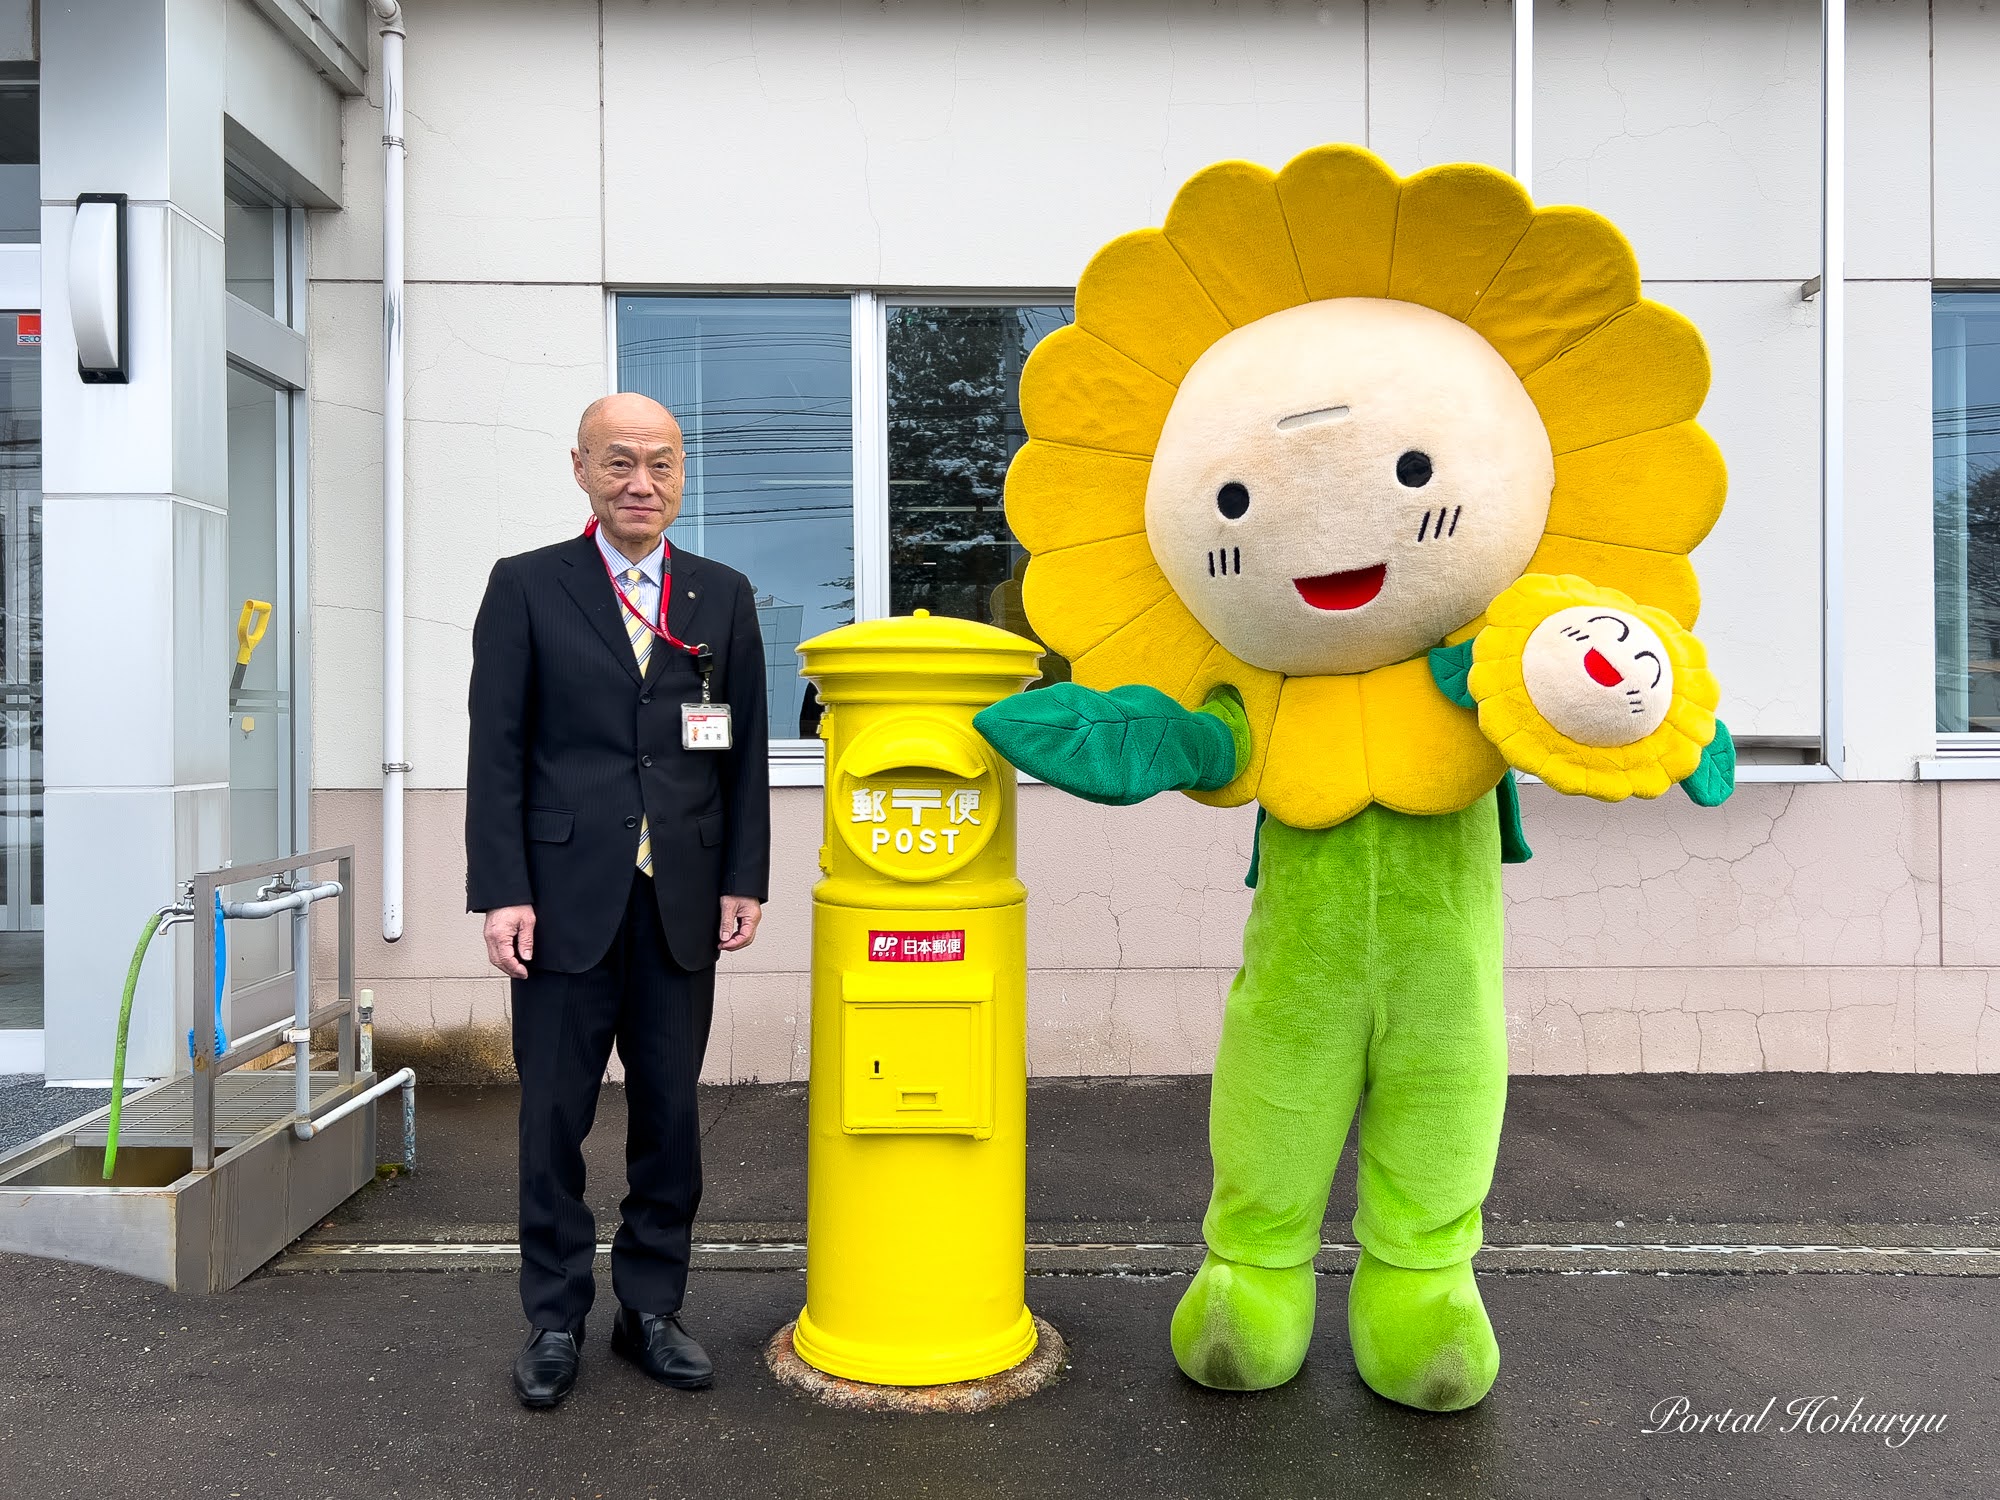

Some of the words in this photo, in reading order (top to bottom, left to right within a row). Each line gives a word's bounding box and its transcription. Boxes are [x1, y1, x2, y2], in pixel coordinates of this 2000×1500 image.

[872, 828, 960, 854] POST
[903, 938, 961, 955] 日本郵便
